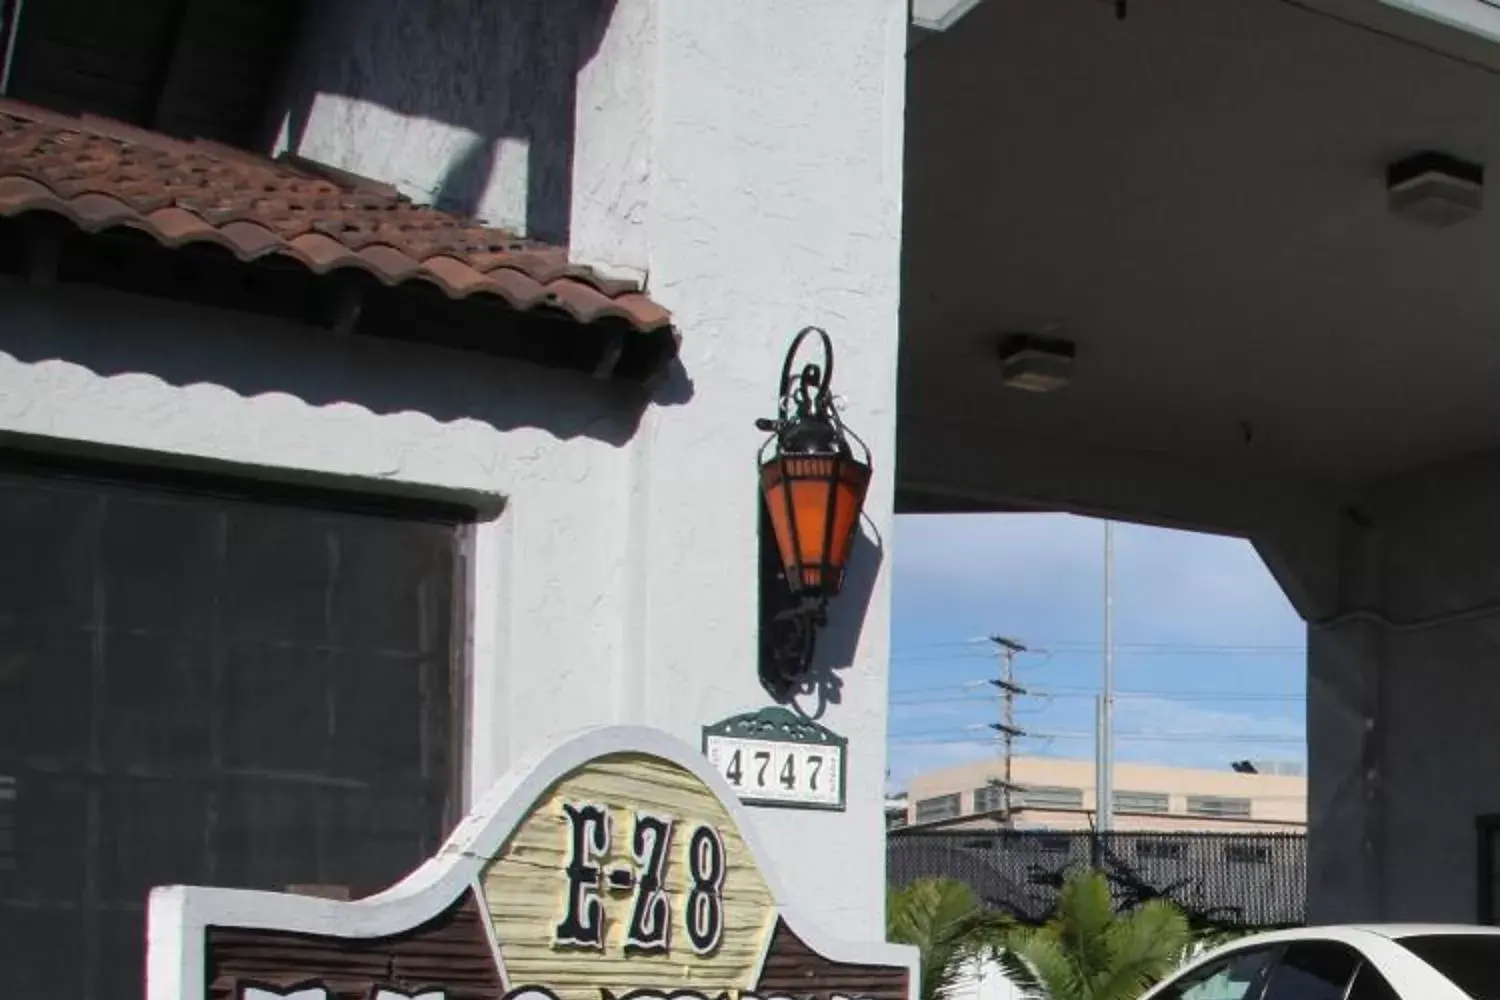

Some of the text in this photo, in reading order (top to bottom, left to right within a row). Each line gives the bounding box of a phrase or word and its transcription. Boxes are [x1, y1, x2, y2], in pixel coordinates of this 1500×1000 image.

[725, 749, 823, 791] 4747
[555, 803, 726, 956] E-Z 8
